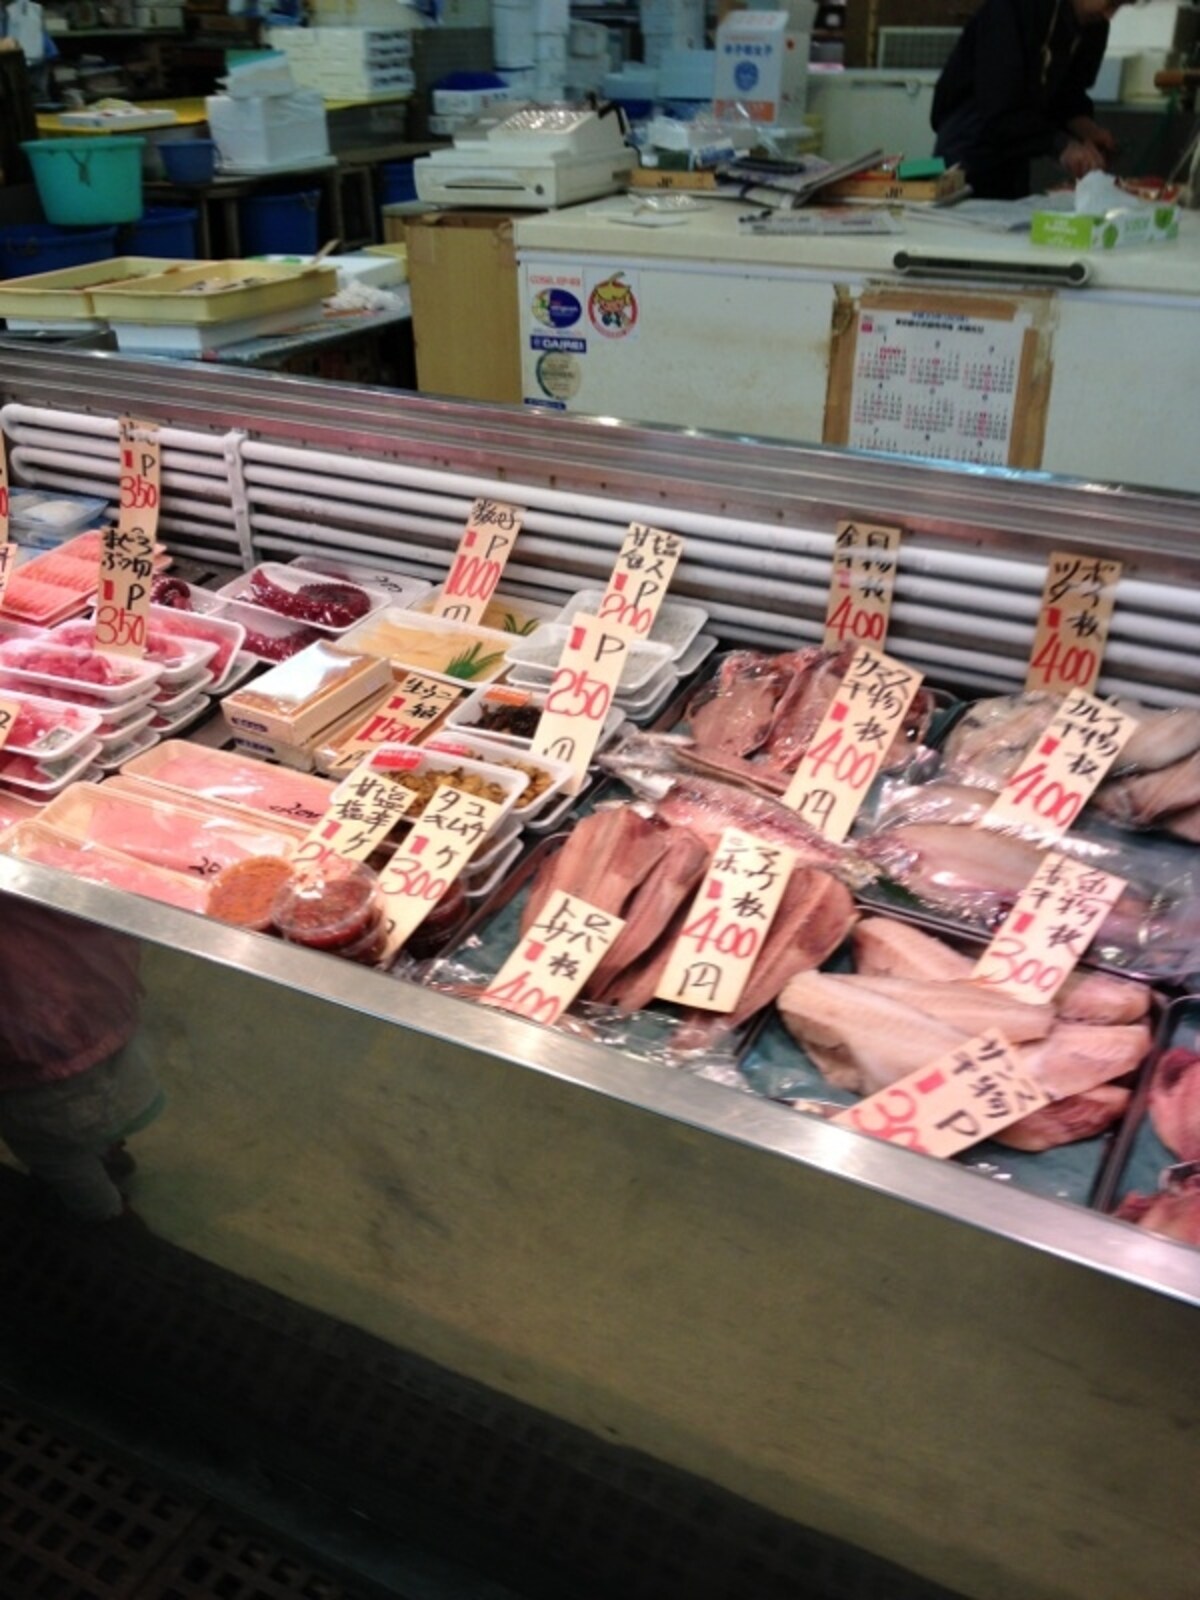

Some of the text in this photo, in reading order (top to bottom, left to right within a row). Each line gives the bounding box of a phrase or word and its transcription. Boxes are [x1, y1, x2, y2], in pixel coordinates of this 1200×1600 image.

[120, 474, 157, 508] 350
[445, 555, 500, 600] 1000
[96, 605, 145, 646] 350
[826, 595, 885, 642] 400
[1032, 633, 1096, 687] 400
[545, 668, 610, 720] 250
[807, 727, 876, 790] 400
[379, 858, 447, 901] 300
[681, 906, 758, 959] 400
[676, 961, 722, 1001] 円
[984, 937, 1062, 992] 300
